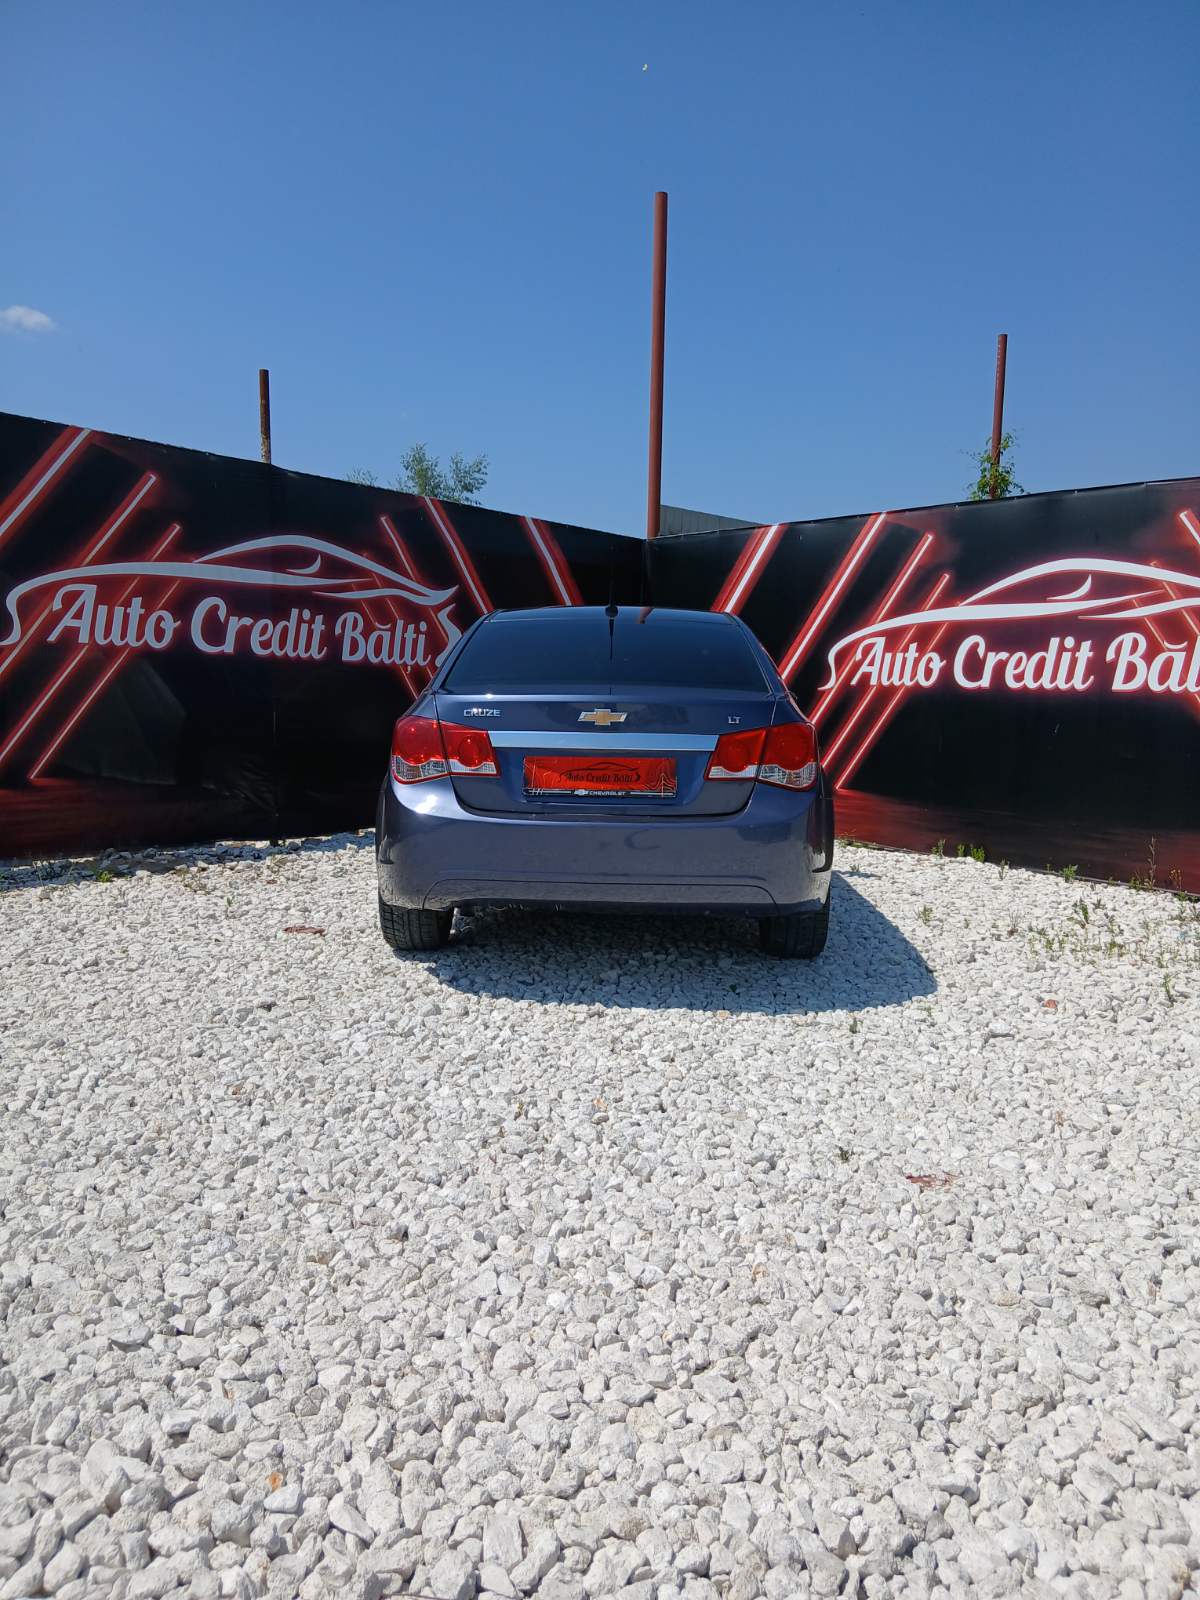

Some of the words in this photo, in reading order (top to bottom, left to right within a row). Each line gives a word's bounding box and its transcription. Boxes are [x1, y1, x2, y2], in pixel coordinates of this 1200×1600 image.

[47, 583, 181, 648] Auto
[190, 596, 327, 658] Credit
[851, 637, 946, 688] Auto
[953, 634, 1095, 690] Credit
[463, 708, 501, 717] CRUZE
[727, 715, 741, 724] LT
